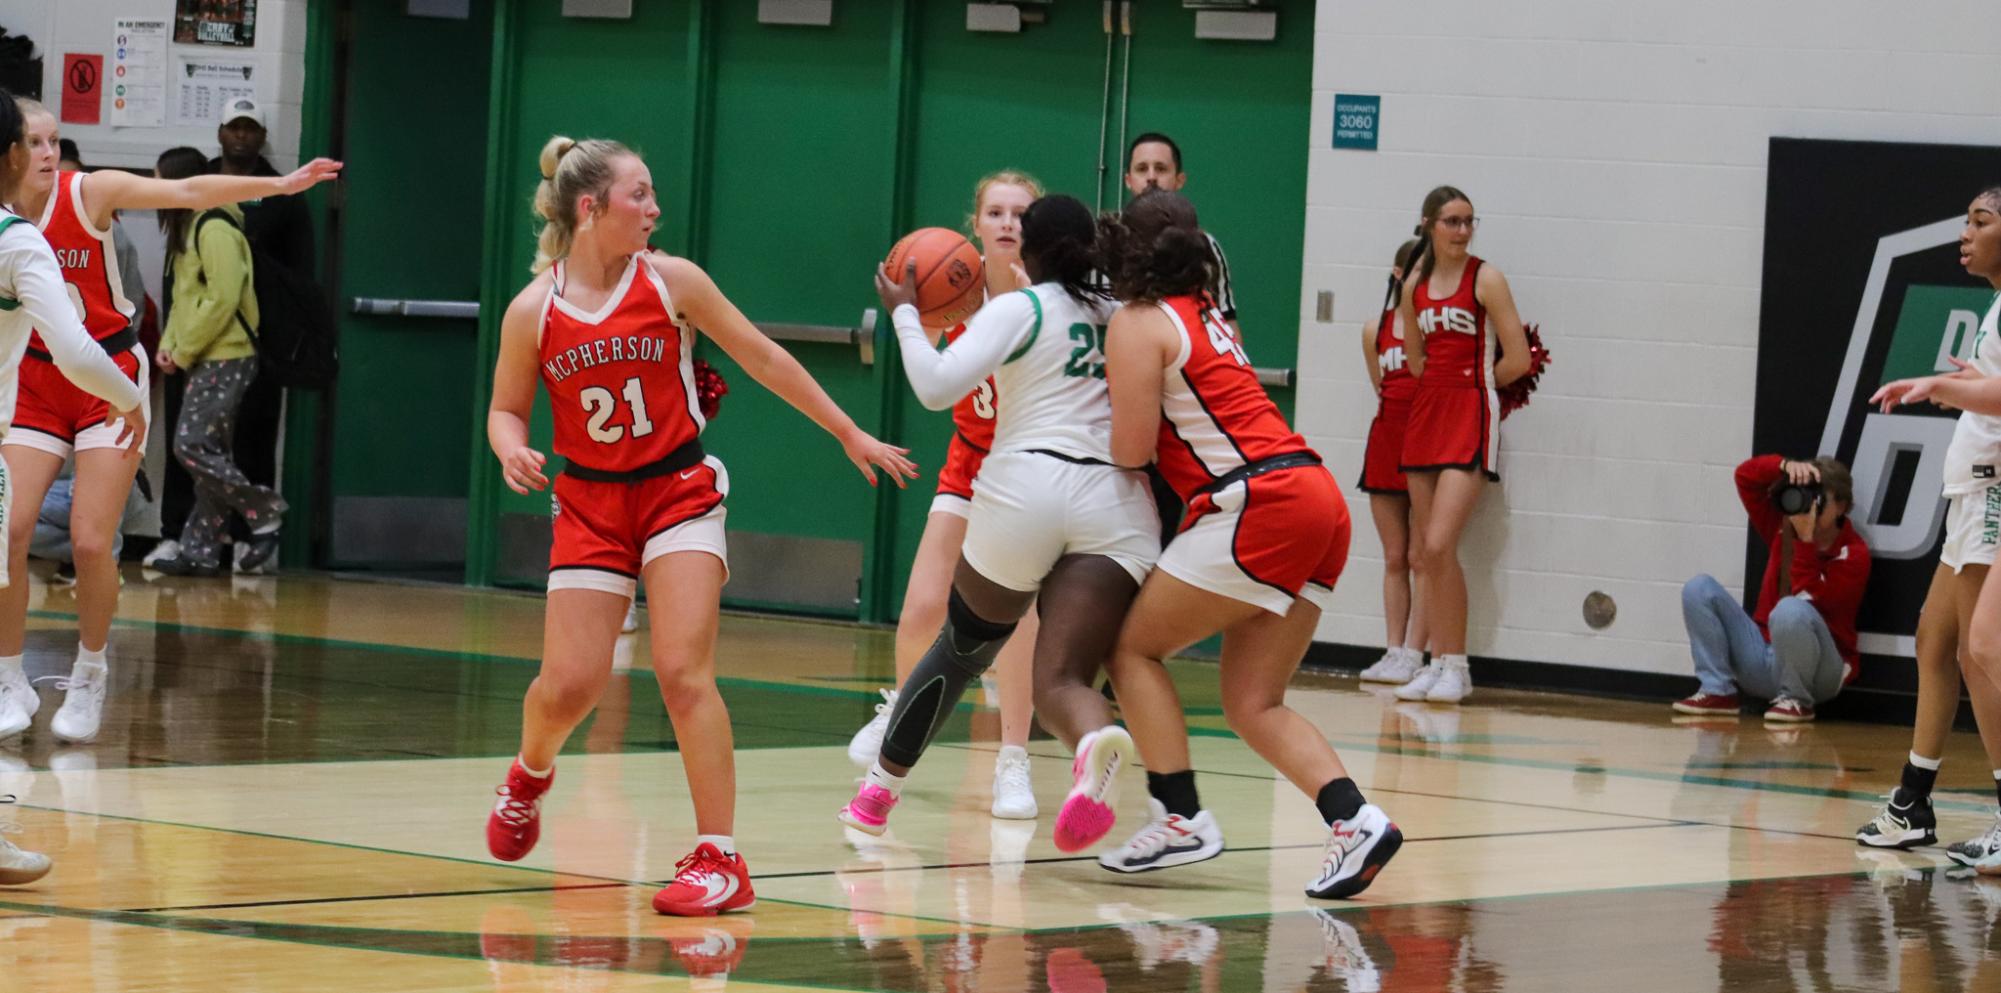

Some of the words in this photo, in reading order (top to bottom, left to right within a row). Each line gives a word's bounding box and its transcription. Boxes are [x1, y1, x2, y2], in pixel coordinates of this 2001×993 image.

[1339, 114, 1372, 129] 3060
[1417, 306, 1477, 336] MHS
[545, 335, 665, 383] MCPHERSON
[1378, 346, 1408, 372] MH
[580, 376, 653, 444] 21
